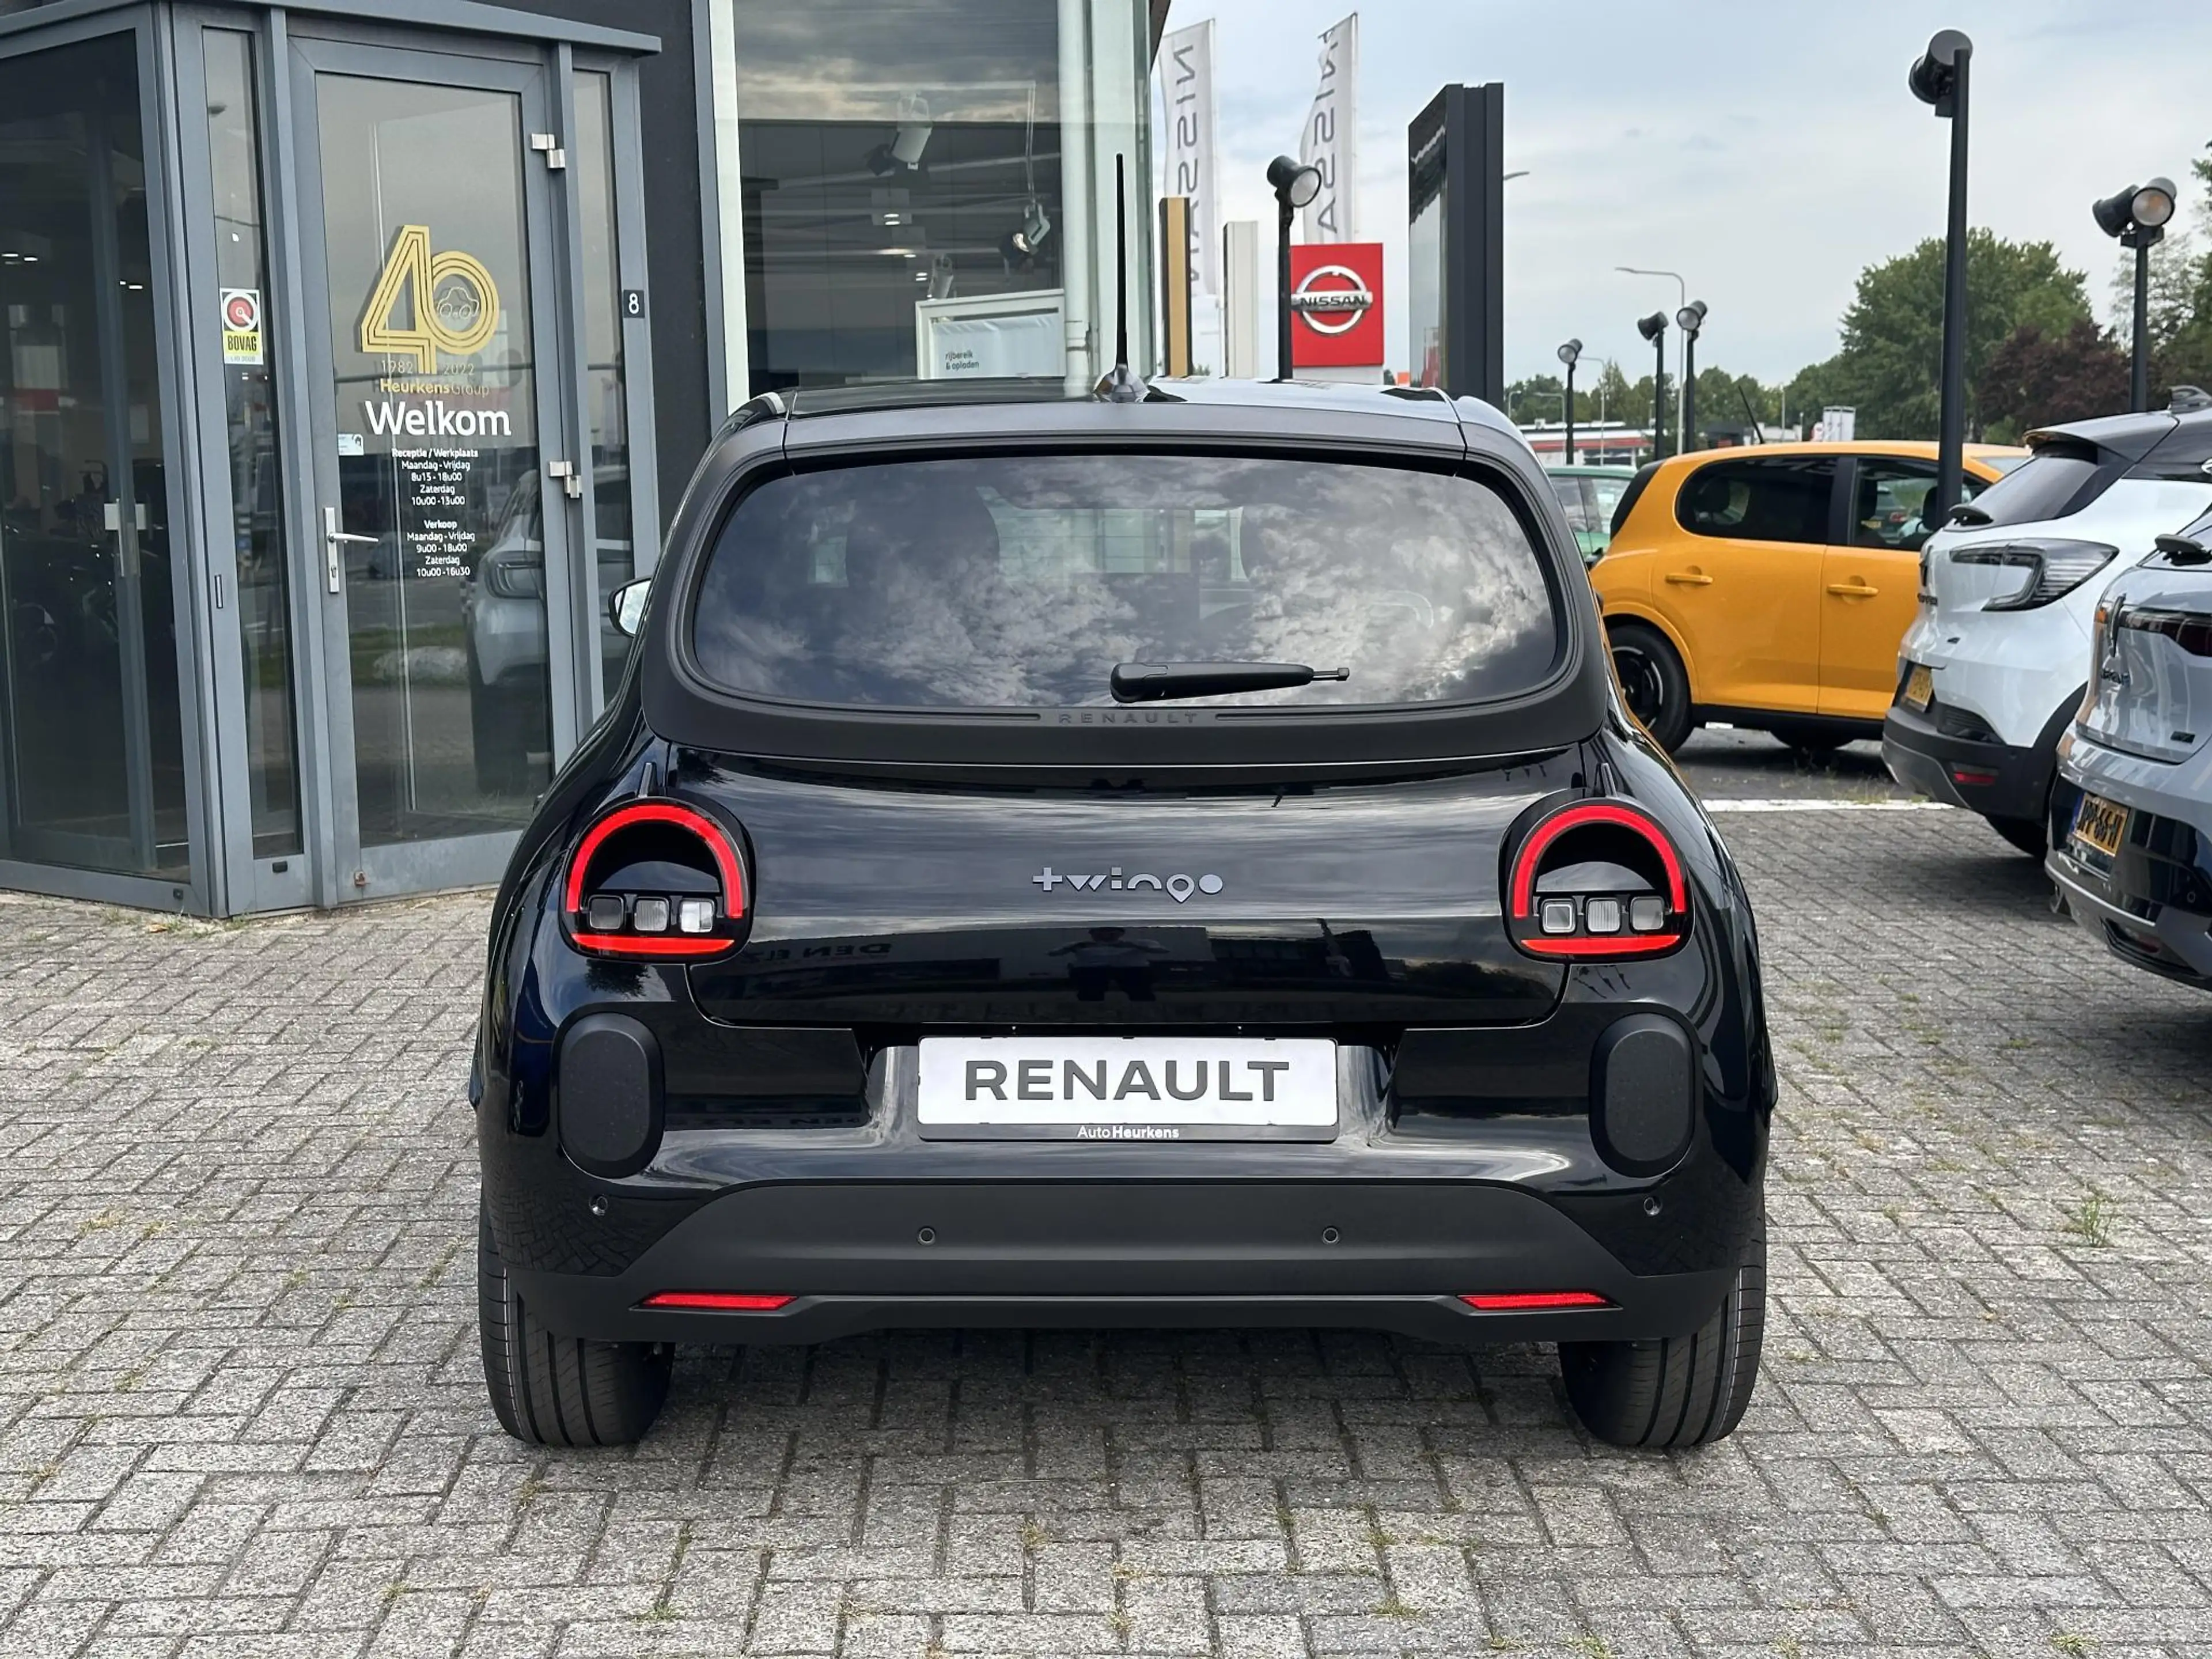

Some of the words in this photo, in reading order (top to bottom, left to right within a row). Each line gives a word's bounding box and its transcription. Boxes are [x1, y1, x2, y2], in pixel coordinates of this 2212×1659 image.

[361, 225, 499, 374] 40
[628, 293, 639, 314] 8
[1300, 294, 1366, 306] NISSAN
[228, 335, 257, 351] BOVAG
[381, 359, 414, 374] 1982
[443, 363, 474, 374] 2022
[952, 361, 979, 370] opladen
[365, 400, 512, 436] Welkom
[392, 448, 427, 459] Receptie
[433, 448, 479, 459] Werkplaats
[402, 460, 438, 471] Maandag
[443, 460, 471, 472] Vrijdag
[411, 472, 431, 482] 8u15
[438, 472, 462, 482] 18u00
[420, 484, 455, 495] Zaterdag
[411, 497, 436, 506] 10u00
[441, 496, 465, 505] 13u00
[423, 519, 457, 530] Verkoop
[407, 531, 443, 543] Maandag
[448, 531, 475, 541] Vrijdag
[416, 544, 437, 553] 9u00
[443, 543, 467, 552] 18u00
[425, 555, 460, 566] Zaterdag
[416, 567, 441, 577] 10u00
[446, 566, 470, 576] 16u30
[1059, 711, 1198, 724] RENAULT
[1032, 866, 1224, 904] twingo
[965, 1059, 1290, 1102] RENAULT
